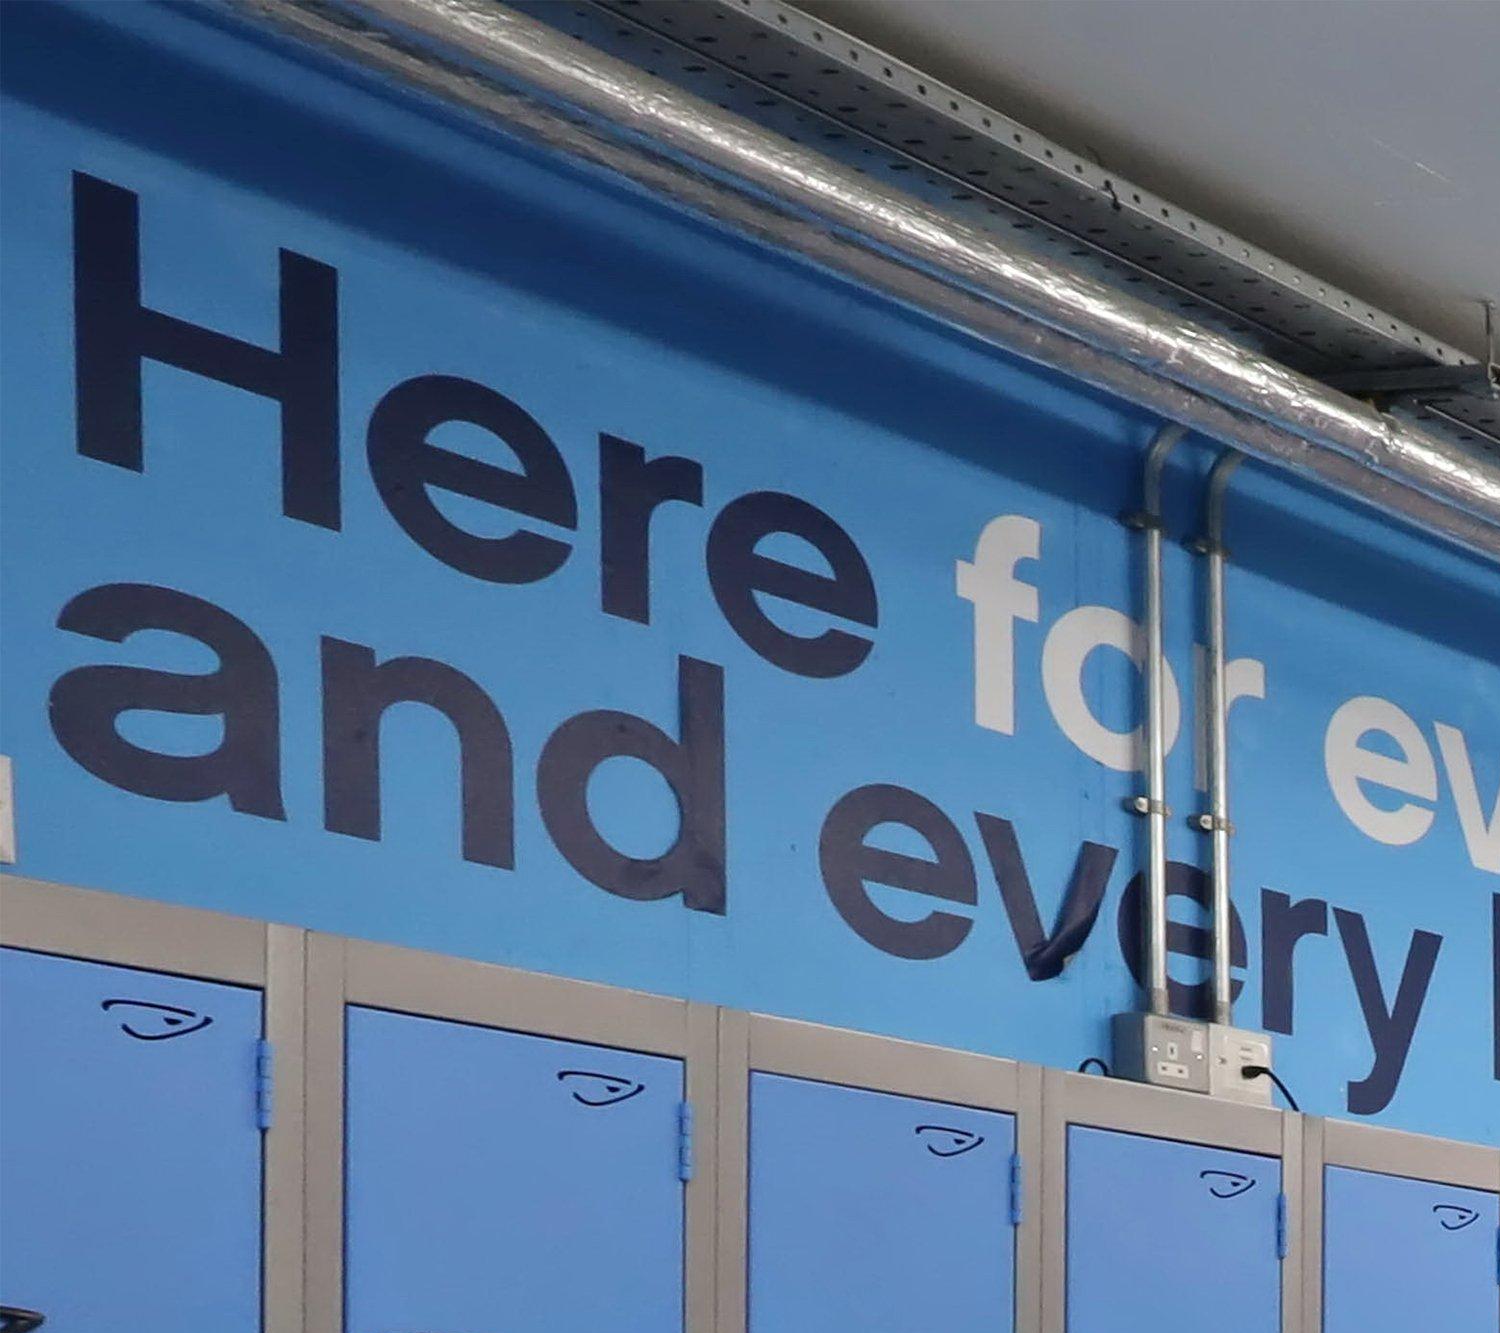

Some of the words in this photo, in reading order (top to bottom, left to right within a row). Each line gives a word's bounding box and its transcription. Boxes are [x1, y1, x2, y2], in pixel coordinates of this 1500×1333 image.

[71, 170, 880, 680] Here
[955, 513, 1266, 794] for
[47, 581, 727, 917] and
[818, 782, 1444, 1116] every
